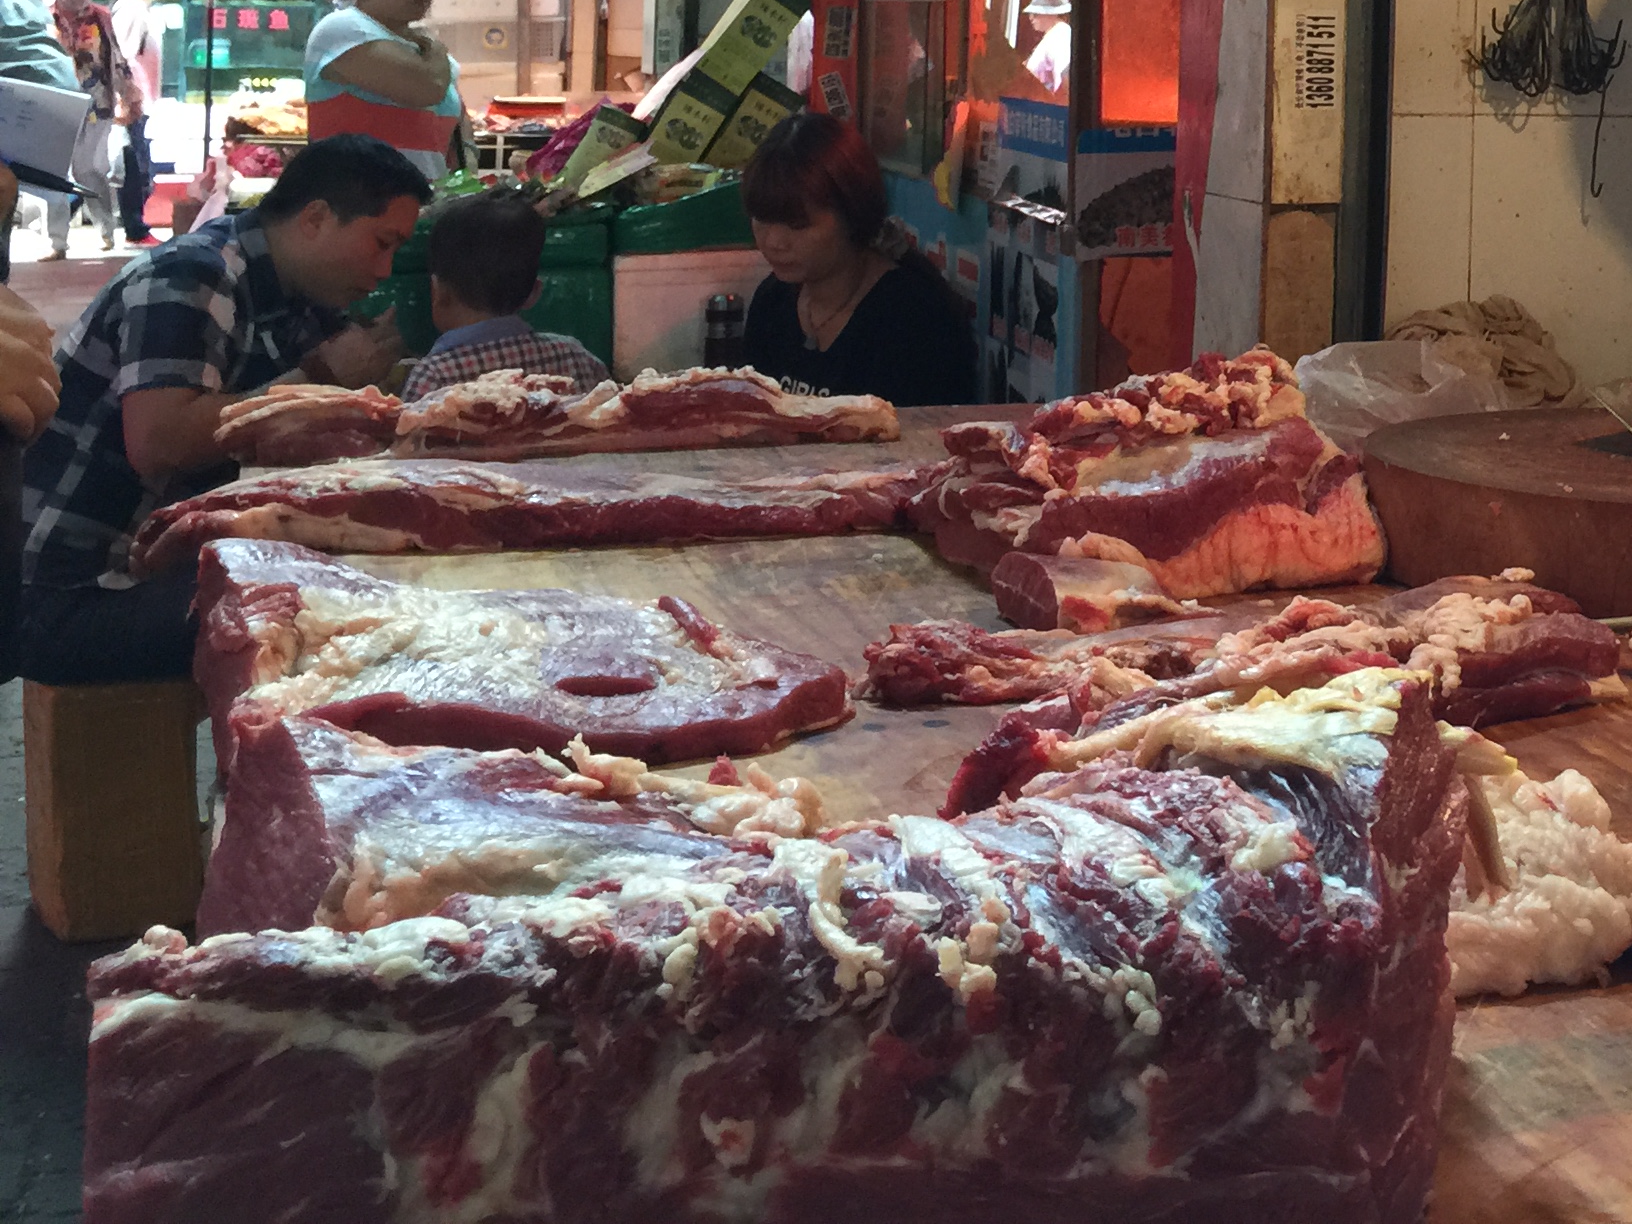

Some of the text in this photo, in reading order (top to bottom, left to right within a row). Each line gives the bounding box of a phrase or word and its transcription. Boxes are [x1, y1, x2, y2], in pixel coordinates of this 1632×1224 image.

[1306, 15, 1336, 38] 511
[1305, 43, 1335, 74] 8871
[1305, 77, 1335, 109] 1360
